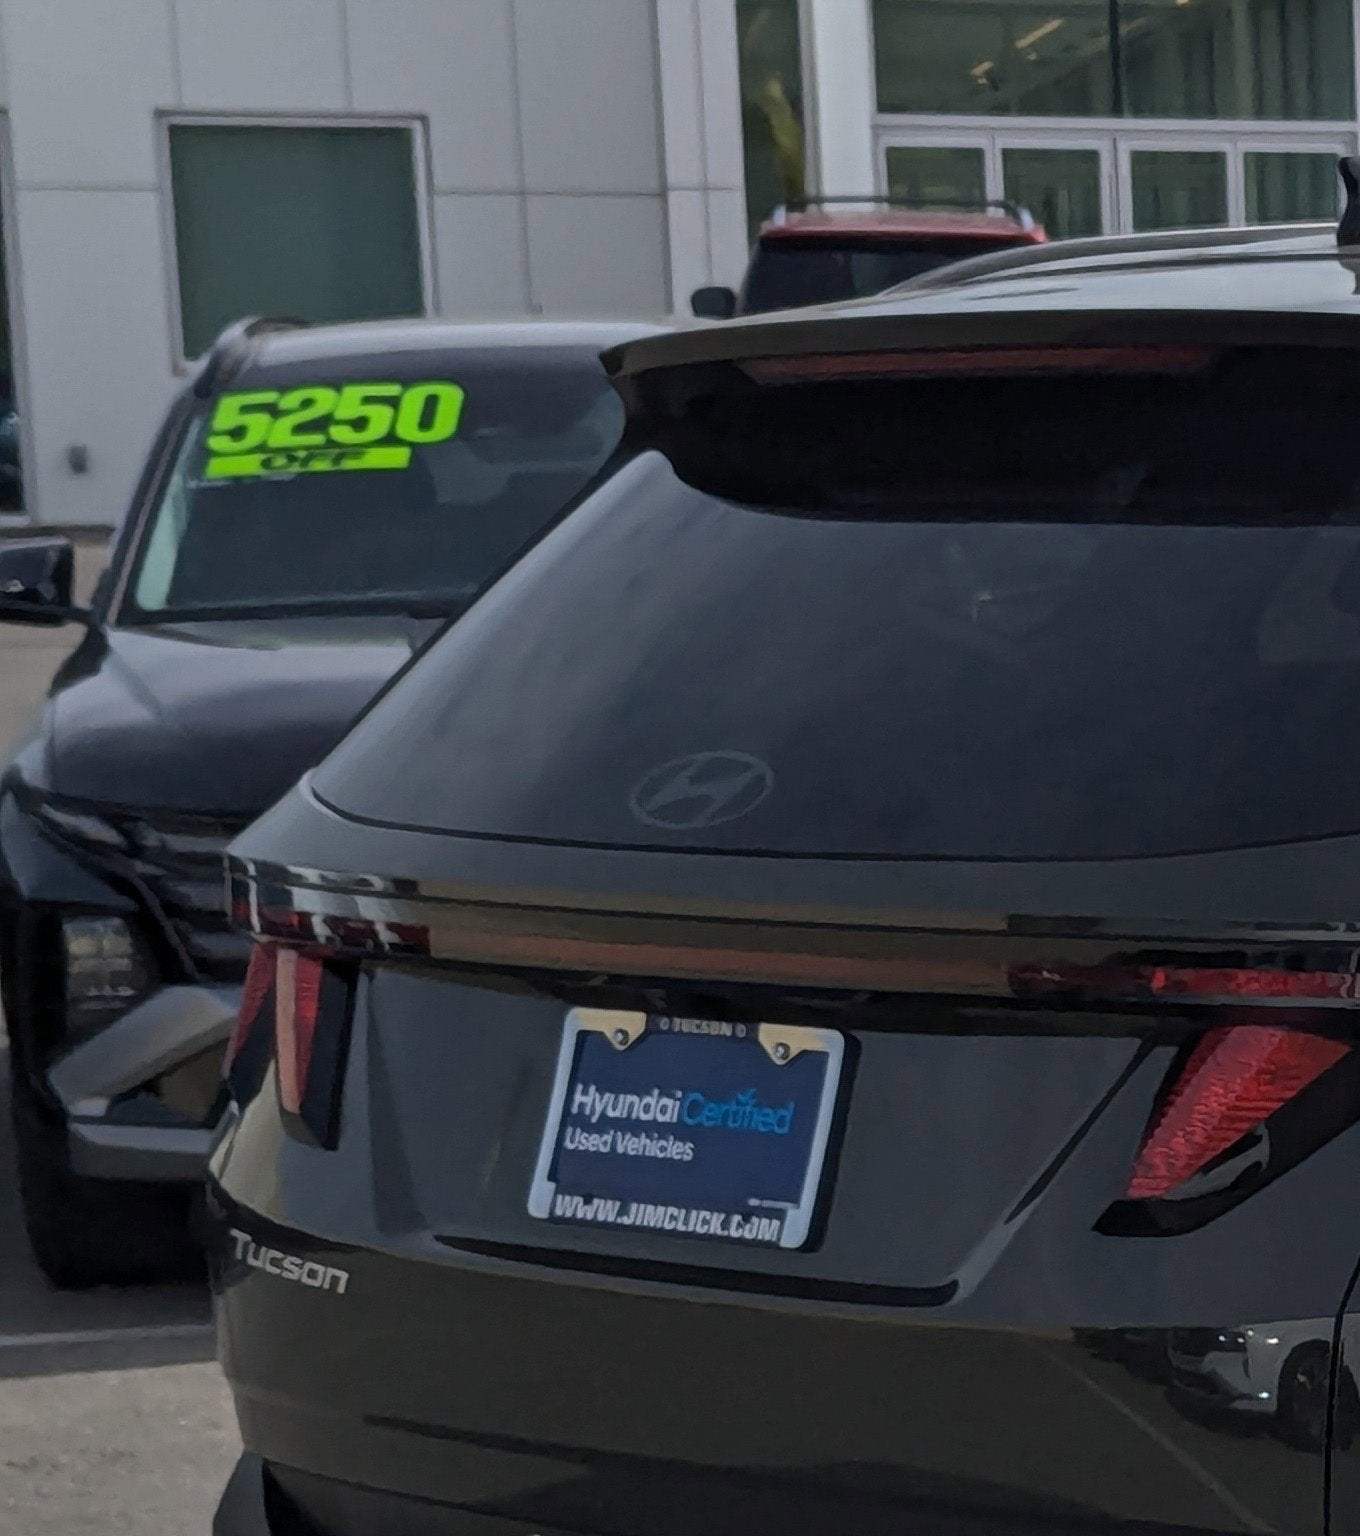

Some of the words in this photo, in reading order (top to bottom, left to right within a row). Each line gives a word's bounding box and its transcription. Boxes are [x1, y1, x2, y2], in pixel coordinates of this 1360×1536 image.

[207, 384, 464, 452] 5250
[260, 449, 366, 471] OFF
[563, 1127, 613, 1154] Used
[614, 1131, 695, 1161] Vehicles
[229, 1227, 349, 1294] Tucson
